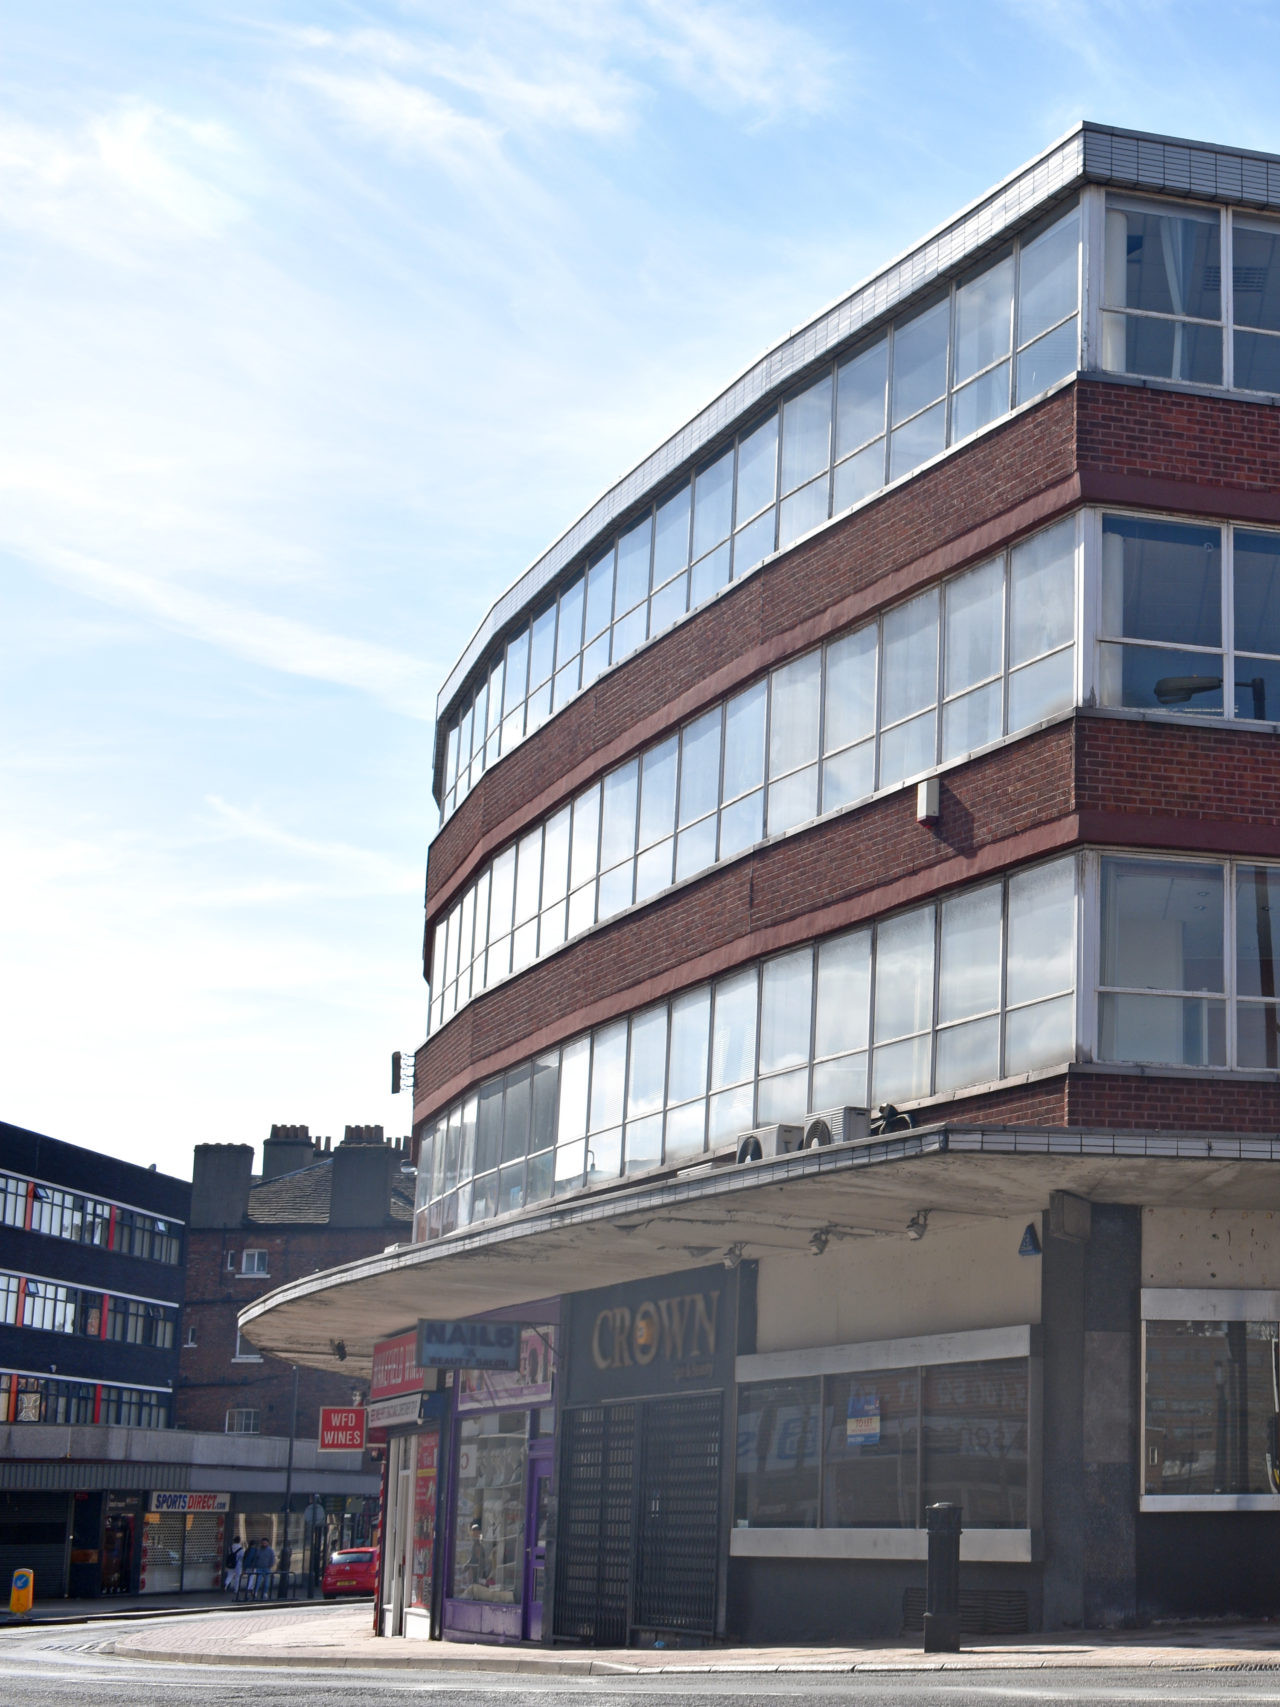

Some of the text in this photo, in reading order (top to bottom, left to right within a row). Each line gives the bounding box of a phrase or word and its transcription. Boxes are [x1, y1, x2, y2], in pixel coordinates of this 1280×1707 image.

[426, 1323, 514, 1348] NAILS
[592, 1289, 720, 1370] CROWN
[429, 1357, 509, 1367] BEAUTY SALON
[331, 1413, 356, 1426] WFD
[324, 1431, 361, 1444] WINES
